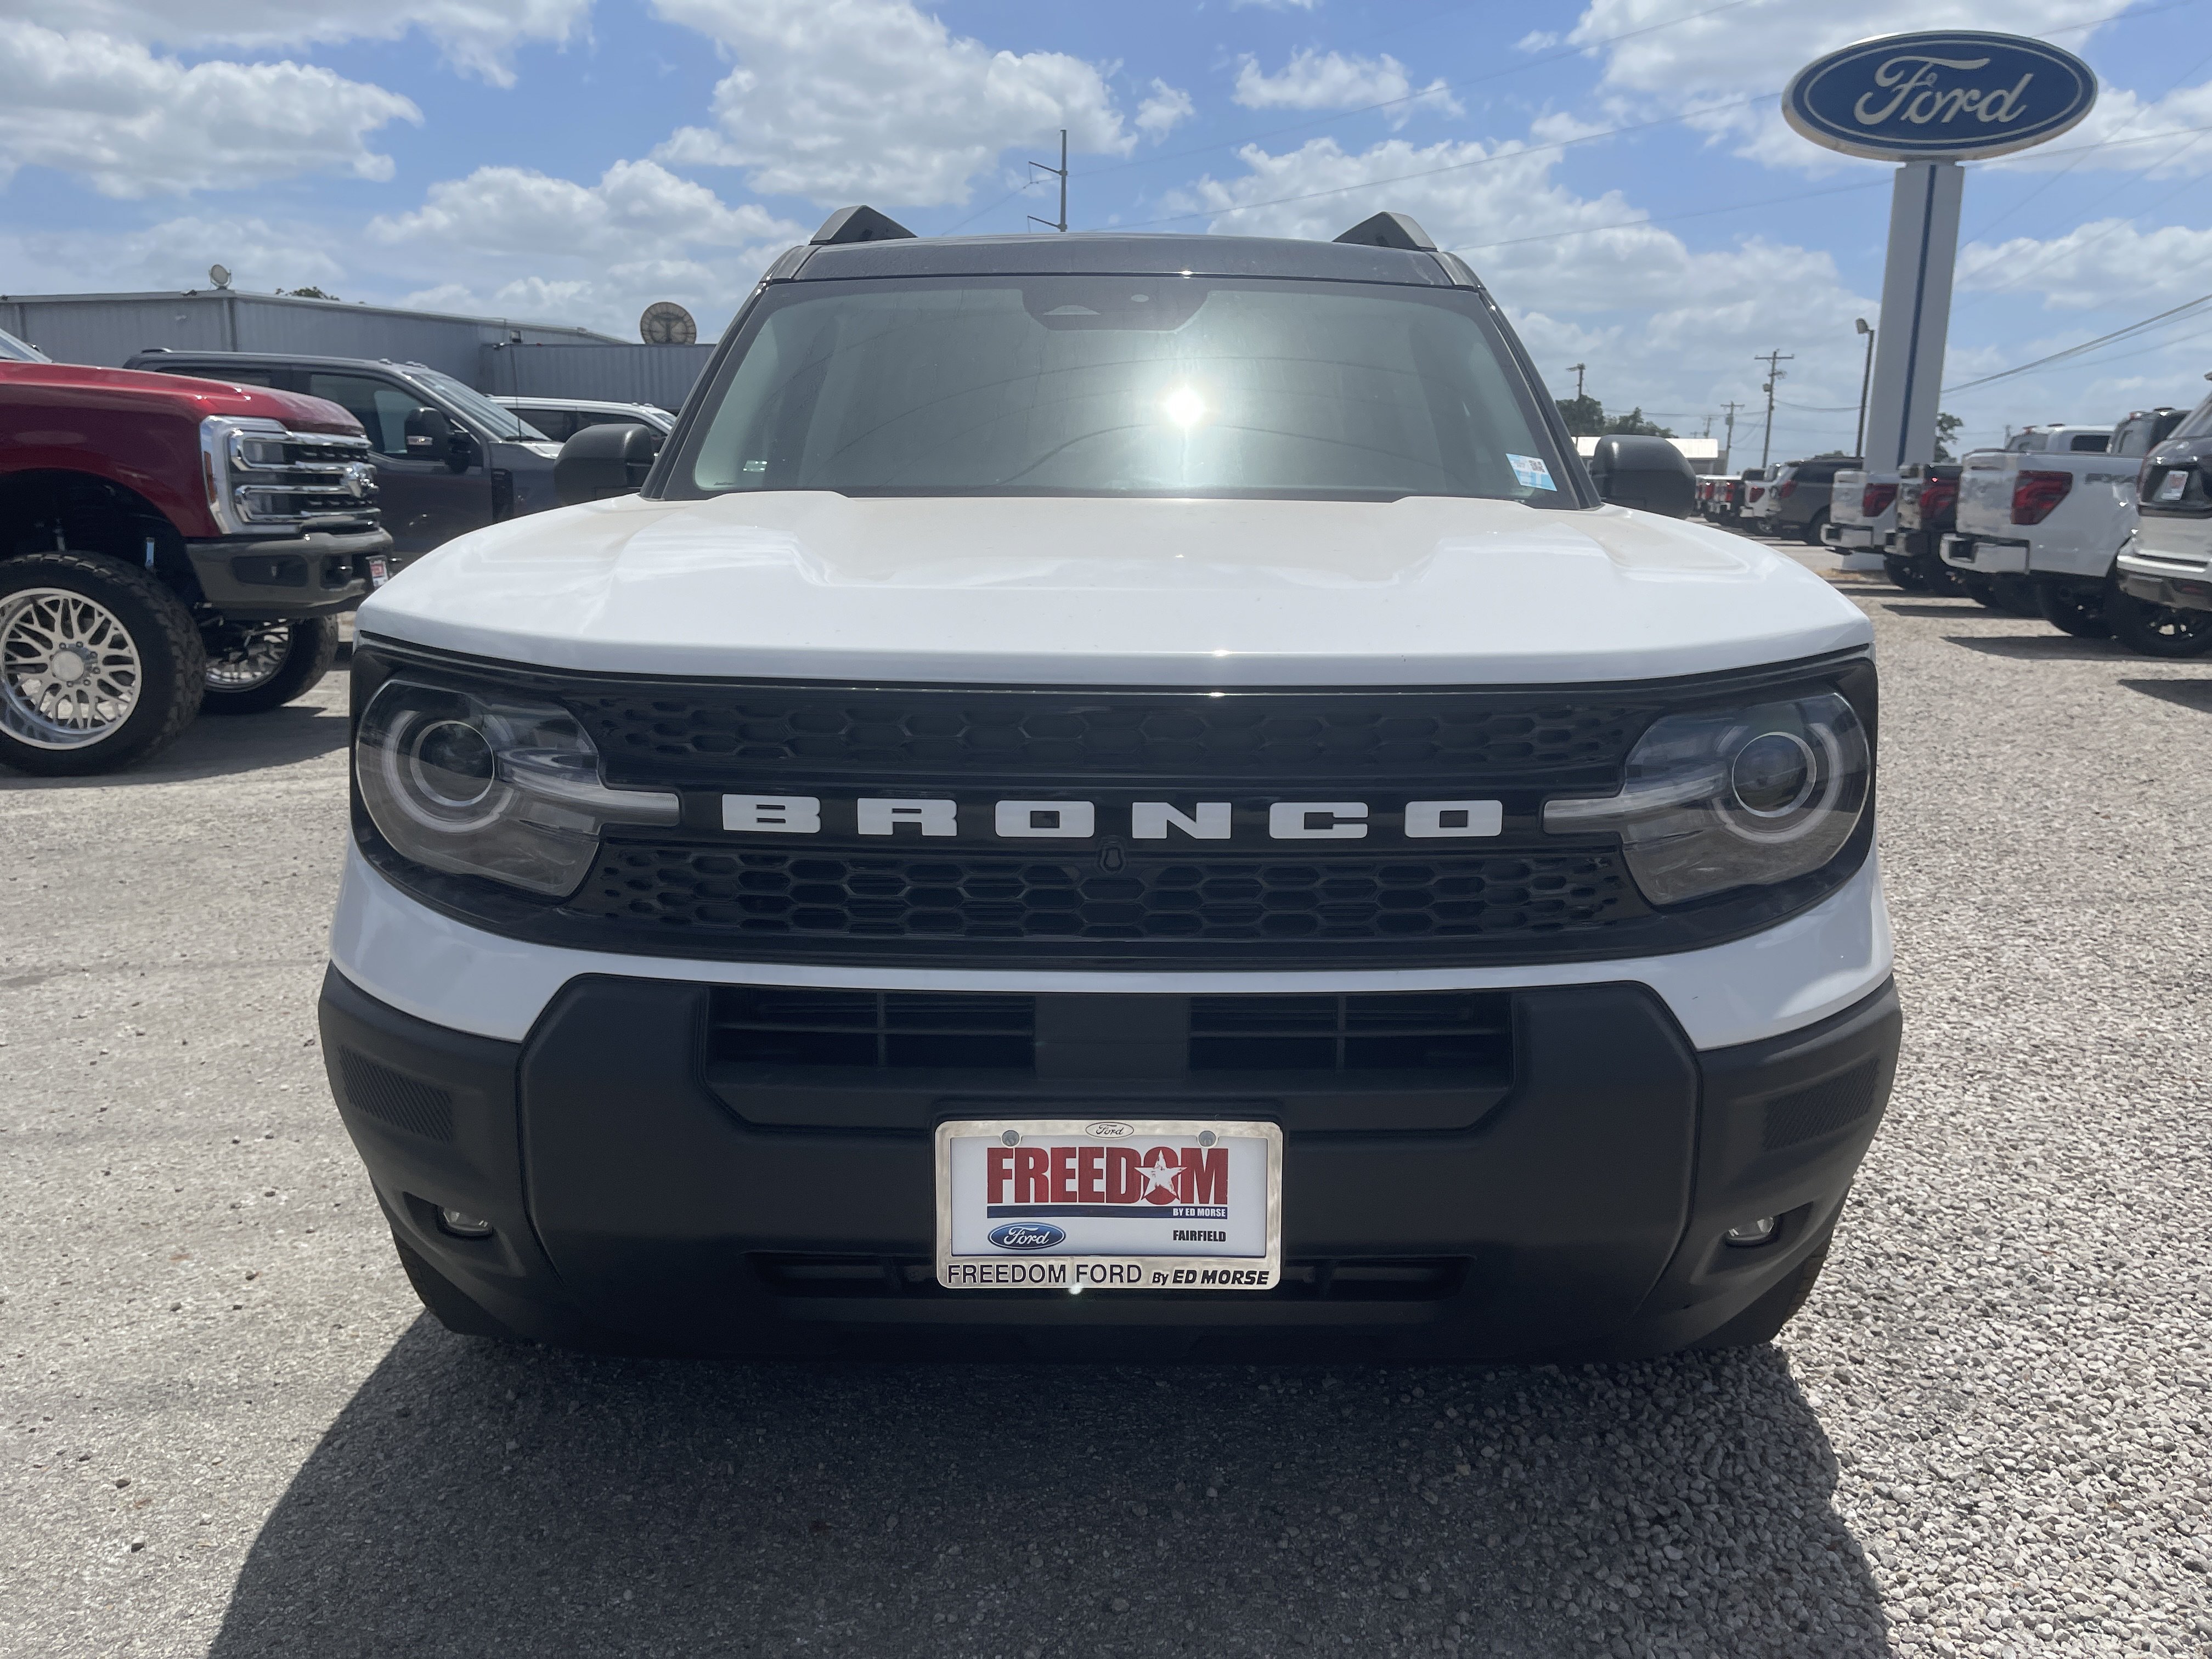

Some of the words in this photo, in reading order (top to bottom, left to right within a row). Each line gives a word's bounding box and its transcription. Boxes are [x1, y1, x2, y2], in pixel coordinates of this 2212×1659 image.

[1854, 55, 2034, 125] Ford
[722, 793, 1504, 840] BRONCO
[1095, 1124, 1124, 1137] Ford
[987, 1147, 1228, 1205] FREEDOM
[1173, 1208, 1184, 1216] BY
[1185, 1208, 1195, 1216] ED
[1197, 1208, 1226, 1217] MORSE
[1003, 1227, 1050, 1245] Ford
[1173, 1230, 1226, 1242] FAIRFIELD
[947, 1264, 1066, 1284] FREEDOM
[1076, 1264, 1142, 1284] FORD
[1152, 1272, 1169, 1285] By
[1172, 1270, 1197, 1284] ED
[1201, 1270, 1269, 1285] MORSE
